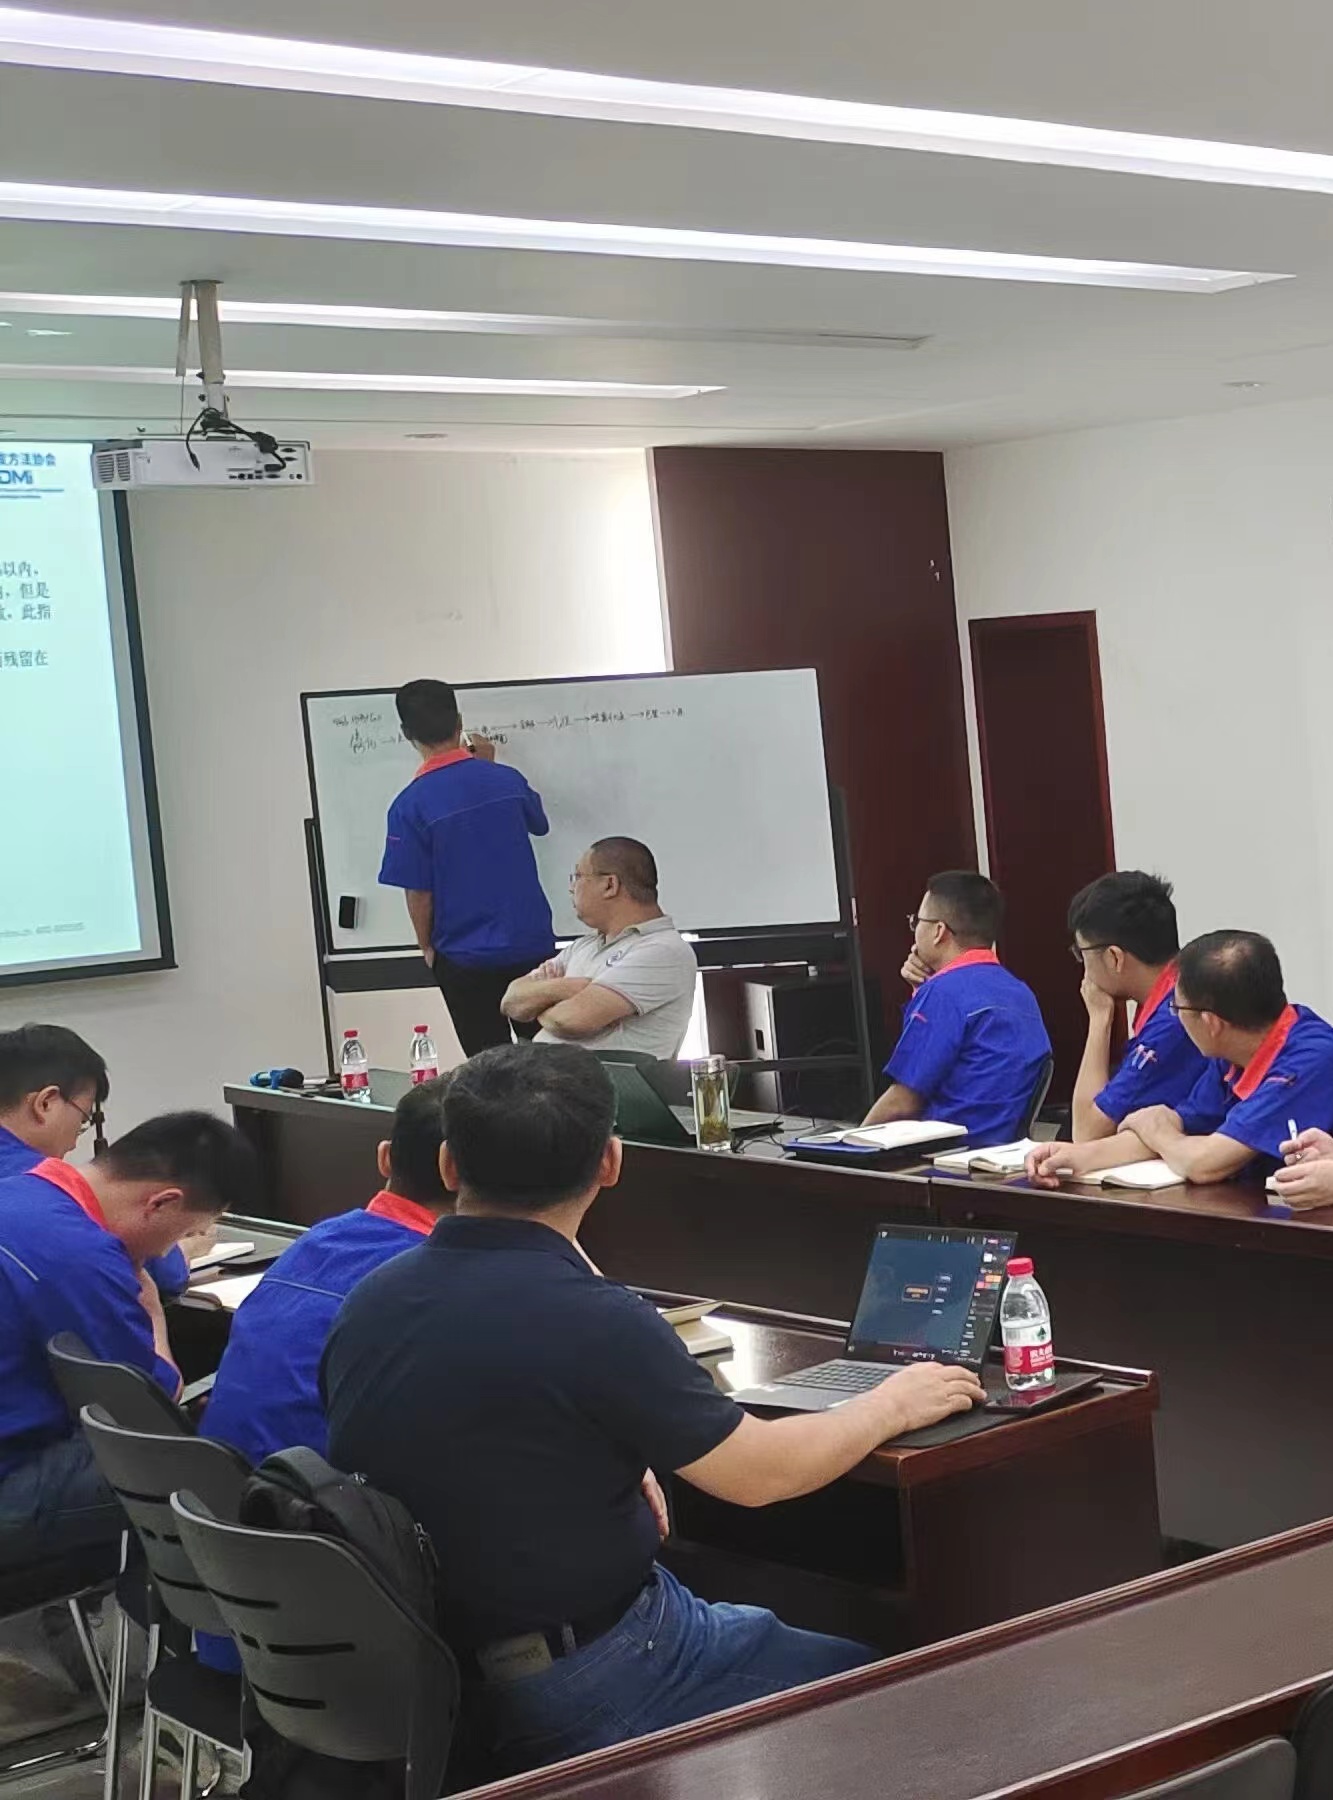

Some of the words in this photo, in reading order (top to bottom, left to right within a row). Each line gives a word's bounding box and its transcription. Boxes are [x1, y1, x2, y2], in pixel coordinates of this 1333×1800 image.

[0, 581, 51, 599] ，但是
[0, 650, 49, 667] 残留在
